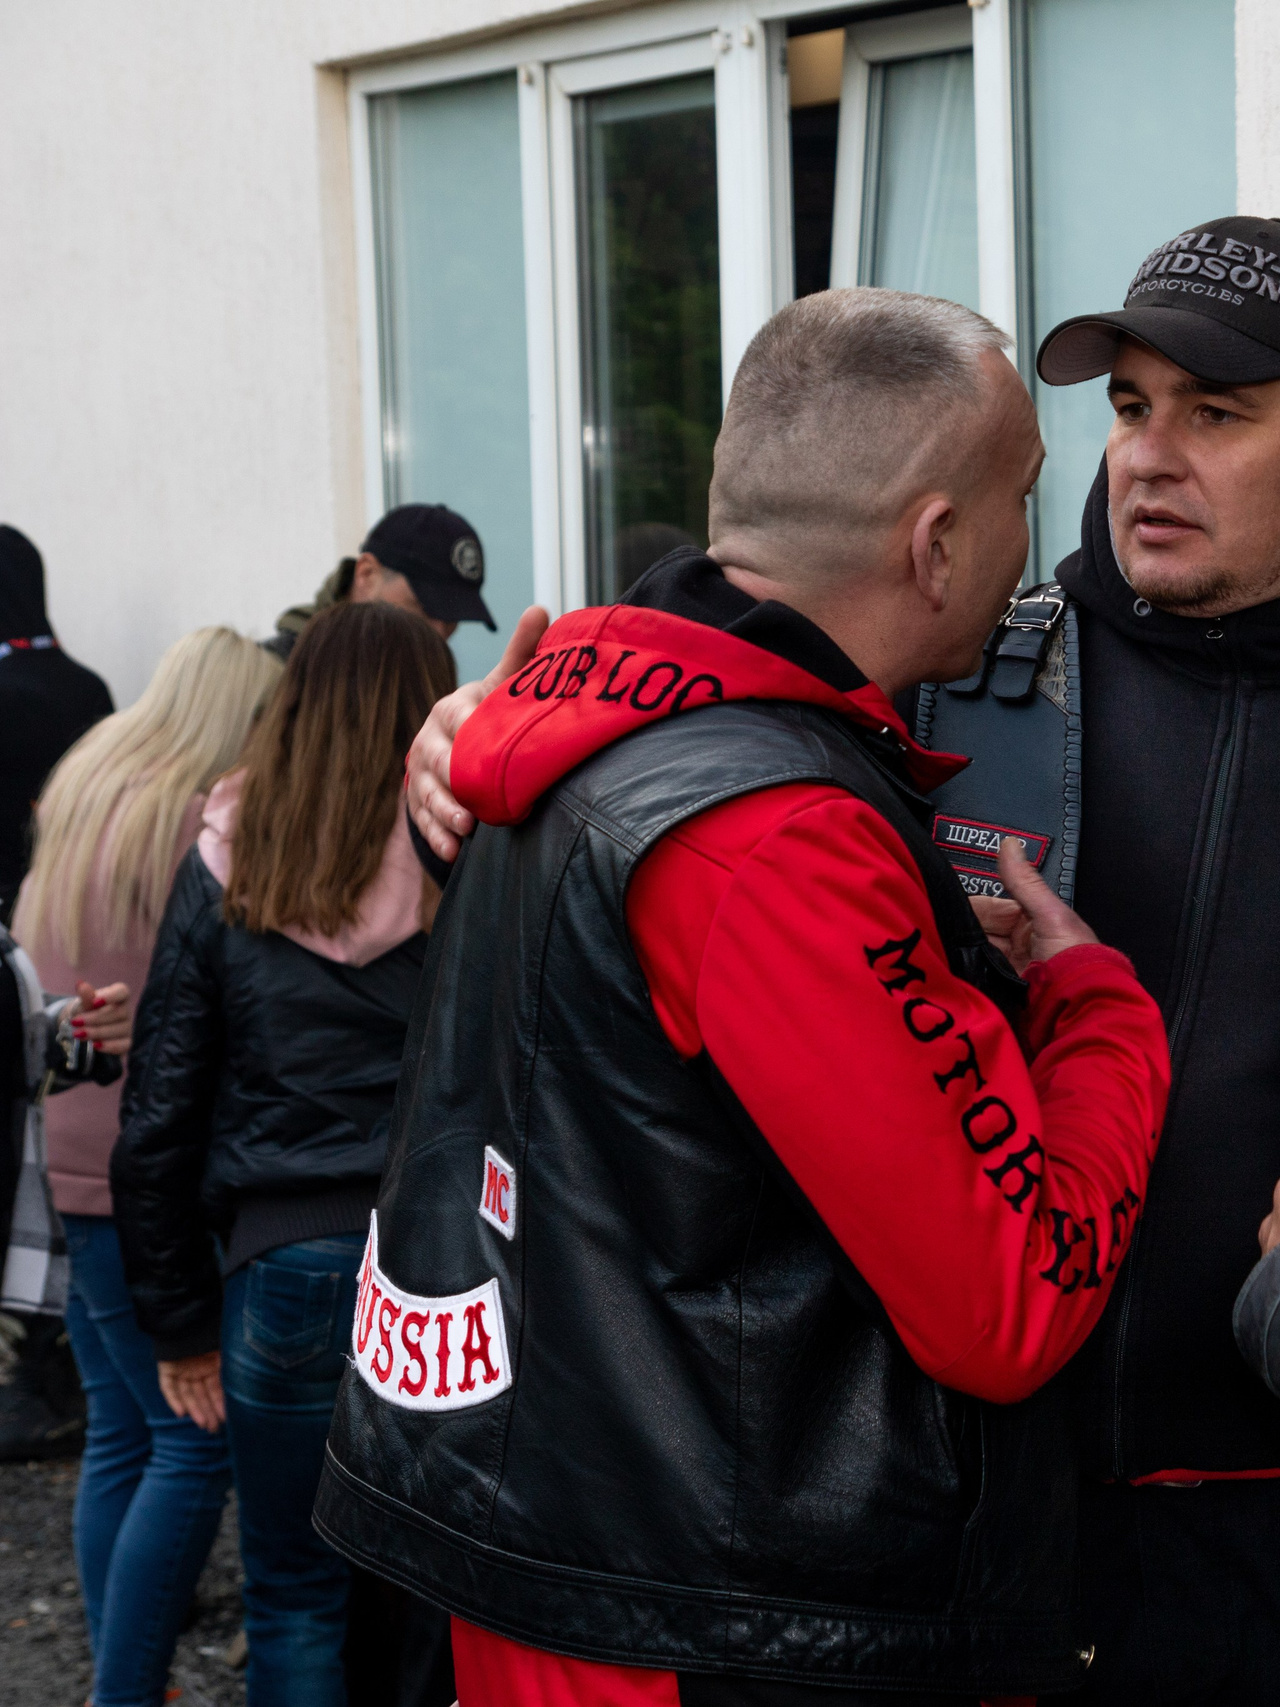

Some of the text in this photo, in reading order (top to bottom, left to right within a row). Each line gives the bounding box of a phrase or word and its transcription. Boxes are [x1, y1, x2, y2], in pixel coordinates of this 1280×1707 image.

[508, 645, 724, 713] OUR LOC
[946, 824, 1027, 854] ШРЕД
[484, 1160, 510, 1223] MC
